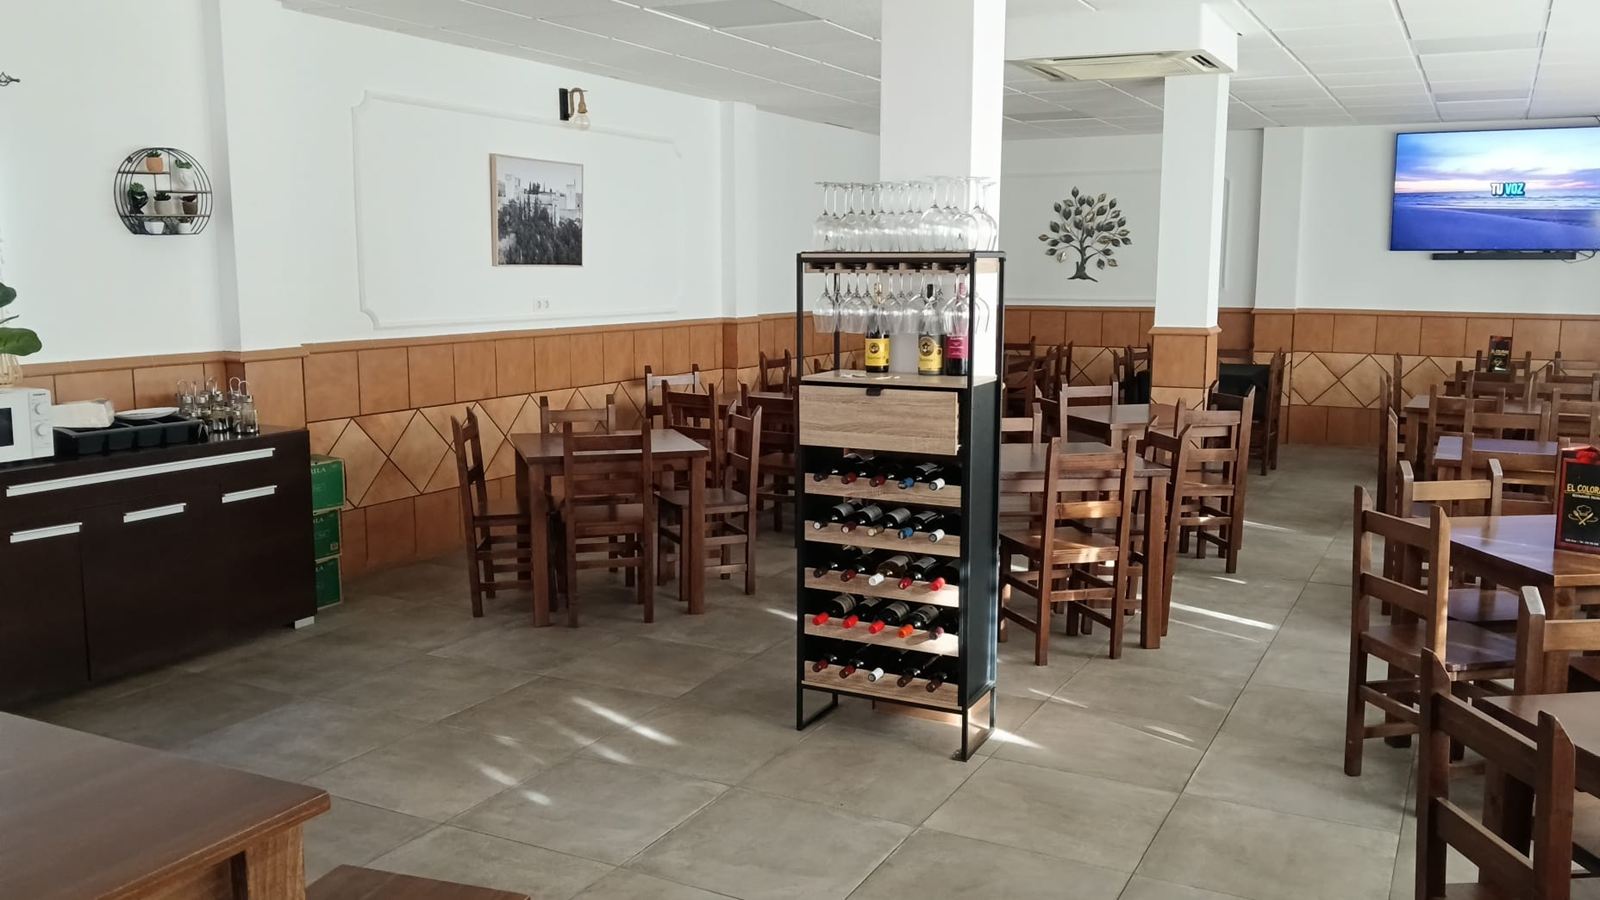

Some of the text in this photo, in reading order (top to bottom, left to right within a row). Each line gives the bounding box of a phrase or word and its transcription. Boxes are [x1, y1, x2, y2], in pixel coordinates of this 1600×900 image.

[1491, 182, 1525, 196] TU VOZ
[1567, 483, 1575, 492] EL
